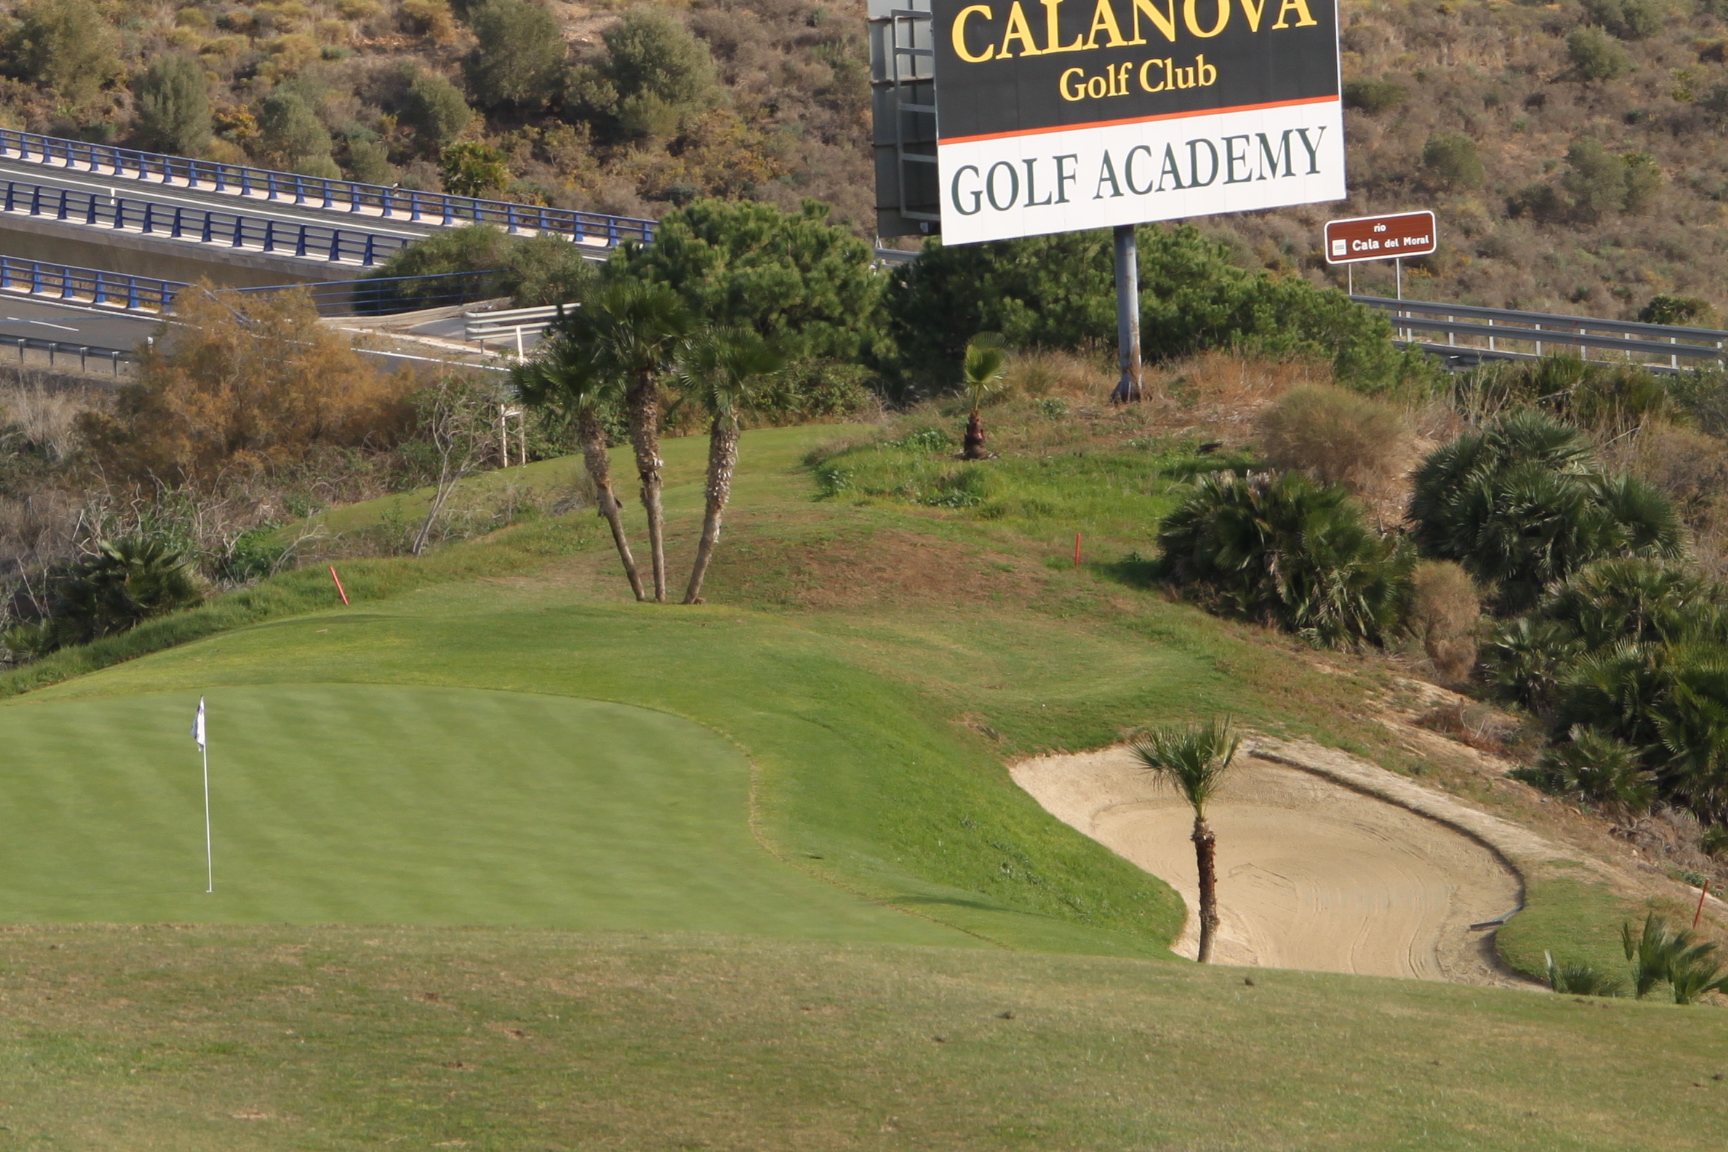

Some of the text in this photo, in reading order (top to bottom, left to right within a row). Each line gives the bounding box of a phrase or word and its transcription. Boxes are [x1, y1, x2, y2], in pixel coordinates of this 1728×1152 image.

[1059, 53, 1217, 102] Golf Club
[950, 125, 1328, 216] GOLF ACADEMY
[1352, 235, 1429, 250] Cala del Moral
